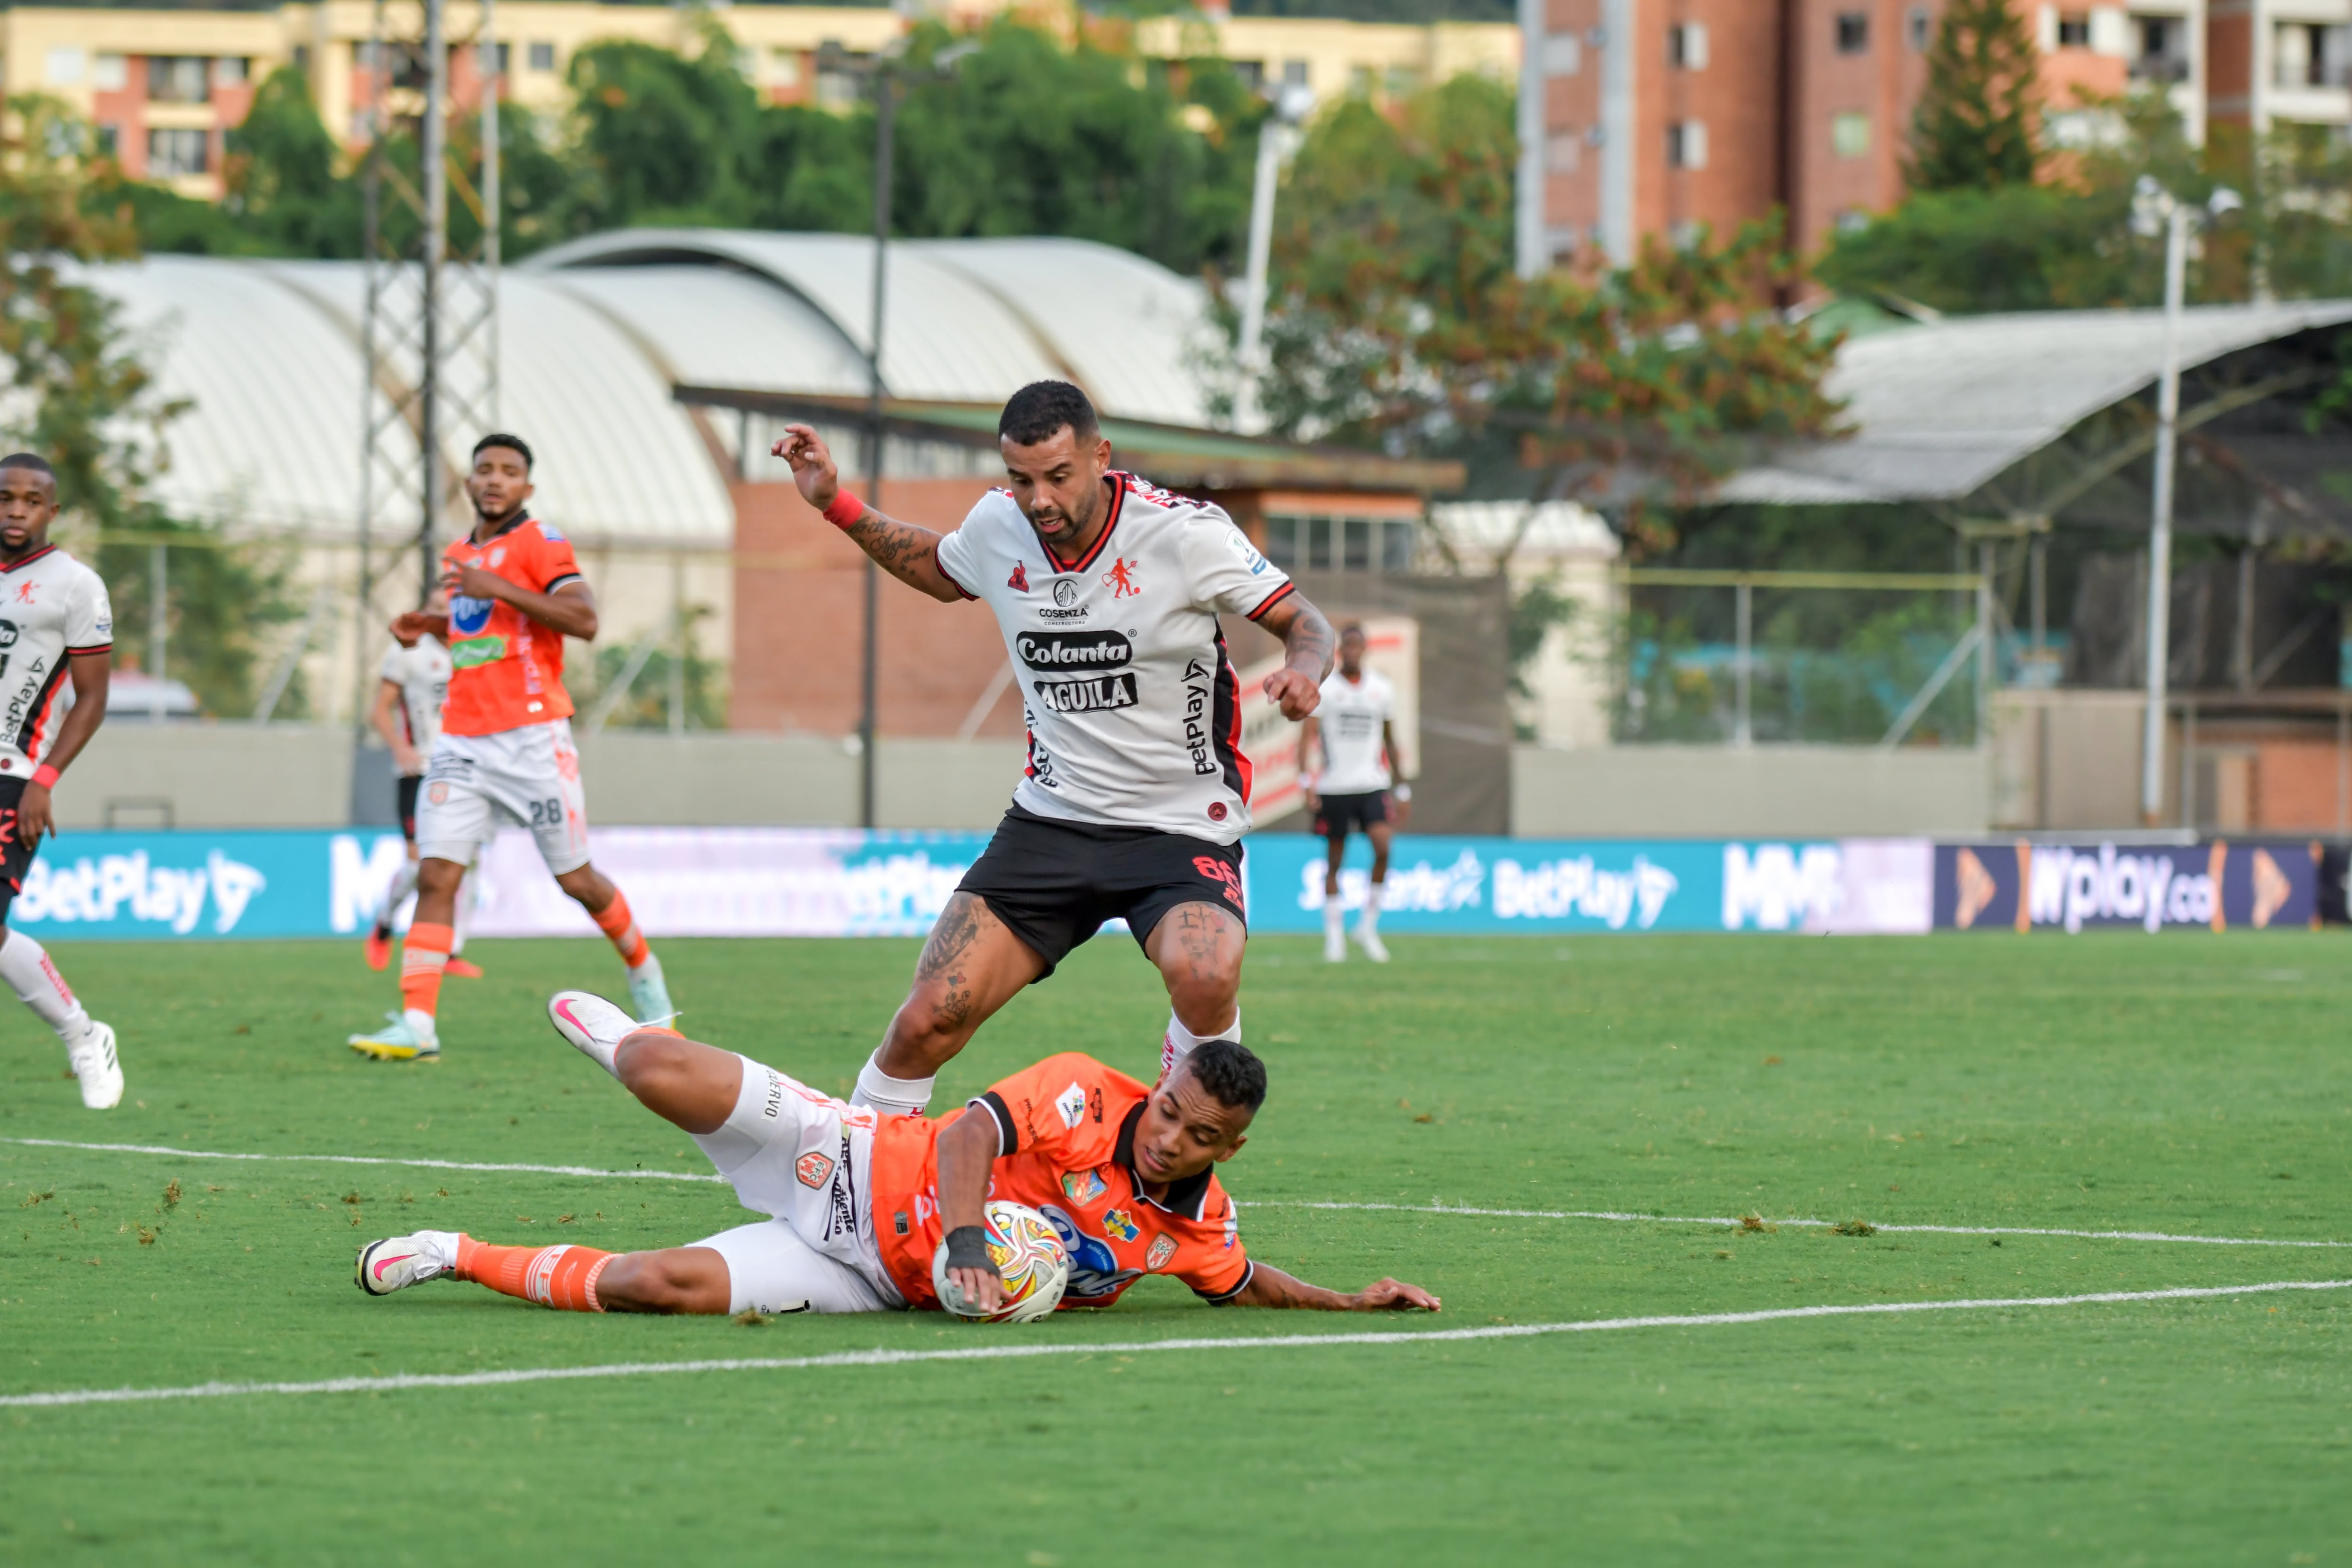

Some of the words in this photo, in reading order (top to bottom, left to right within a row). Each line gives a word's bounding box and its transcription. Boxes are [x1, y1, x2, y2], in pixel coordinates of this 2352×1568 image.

[1039, 607, 1089, 618] COSENZA
[1017, 637, 1128, 664] Colanta
[0, 676, 39, 743] BetPlay
[1182, 685, 1217, 776] BetPlay
[530, 799, 562, 824] 28
[14, 849, 208, 934] BetPlay
[1492, 854, 1634, 930] BetPlay
[809, 1161, 825, 1182] EFC
[1155, 1242, 1170, 1257] EFC
